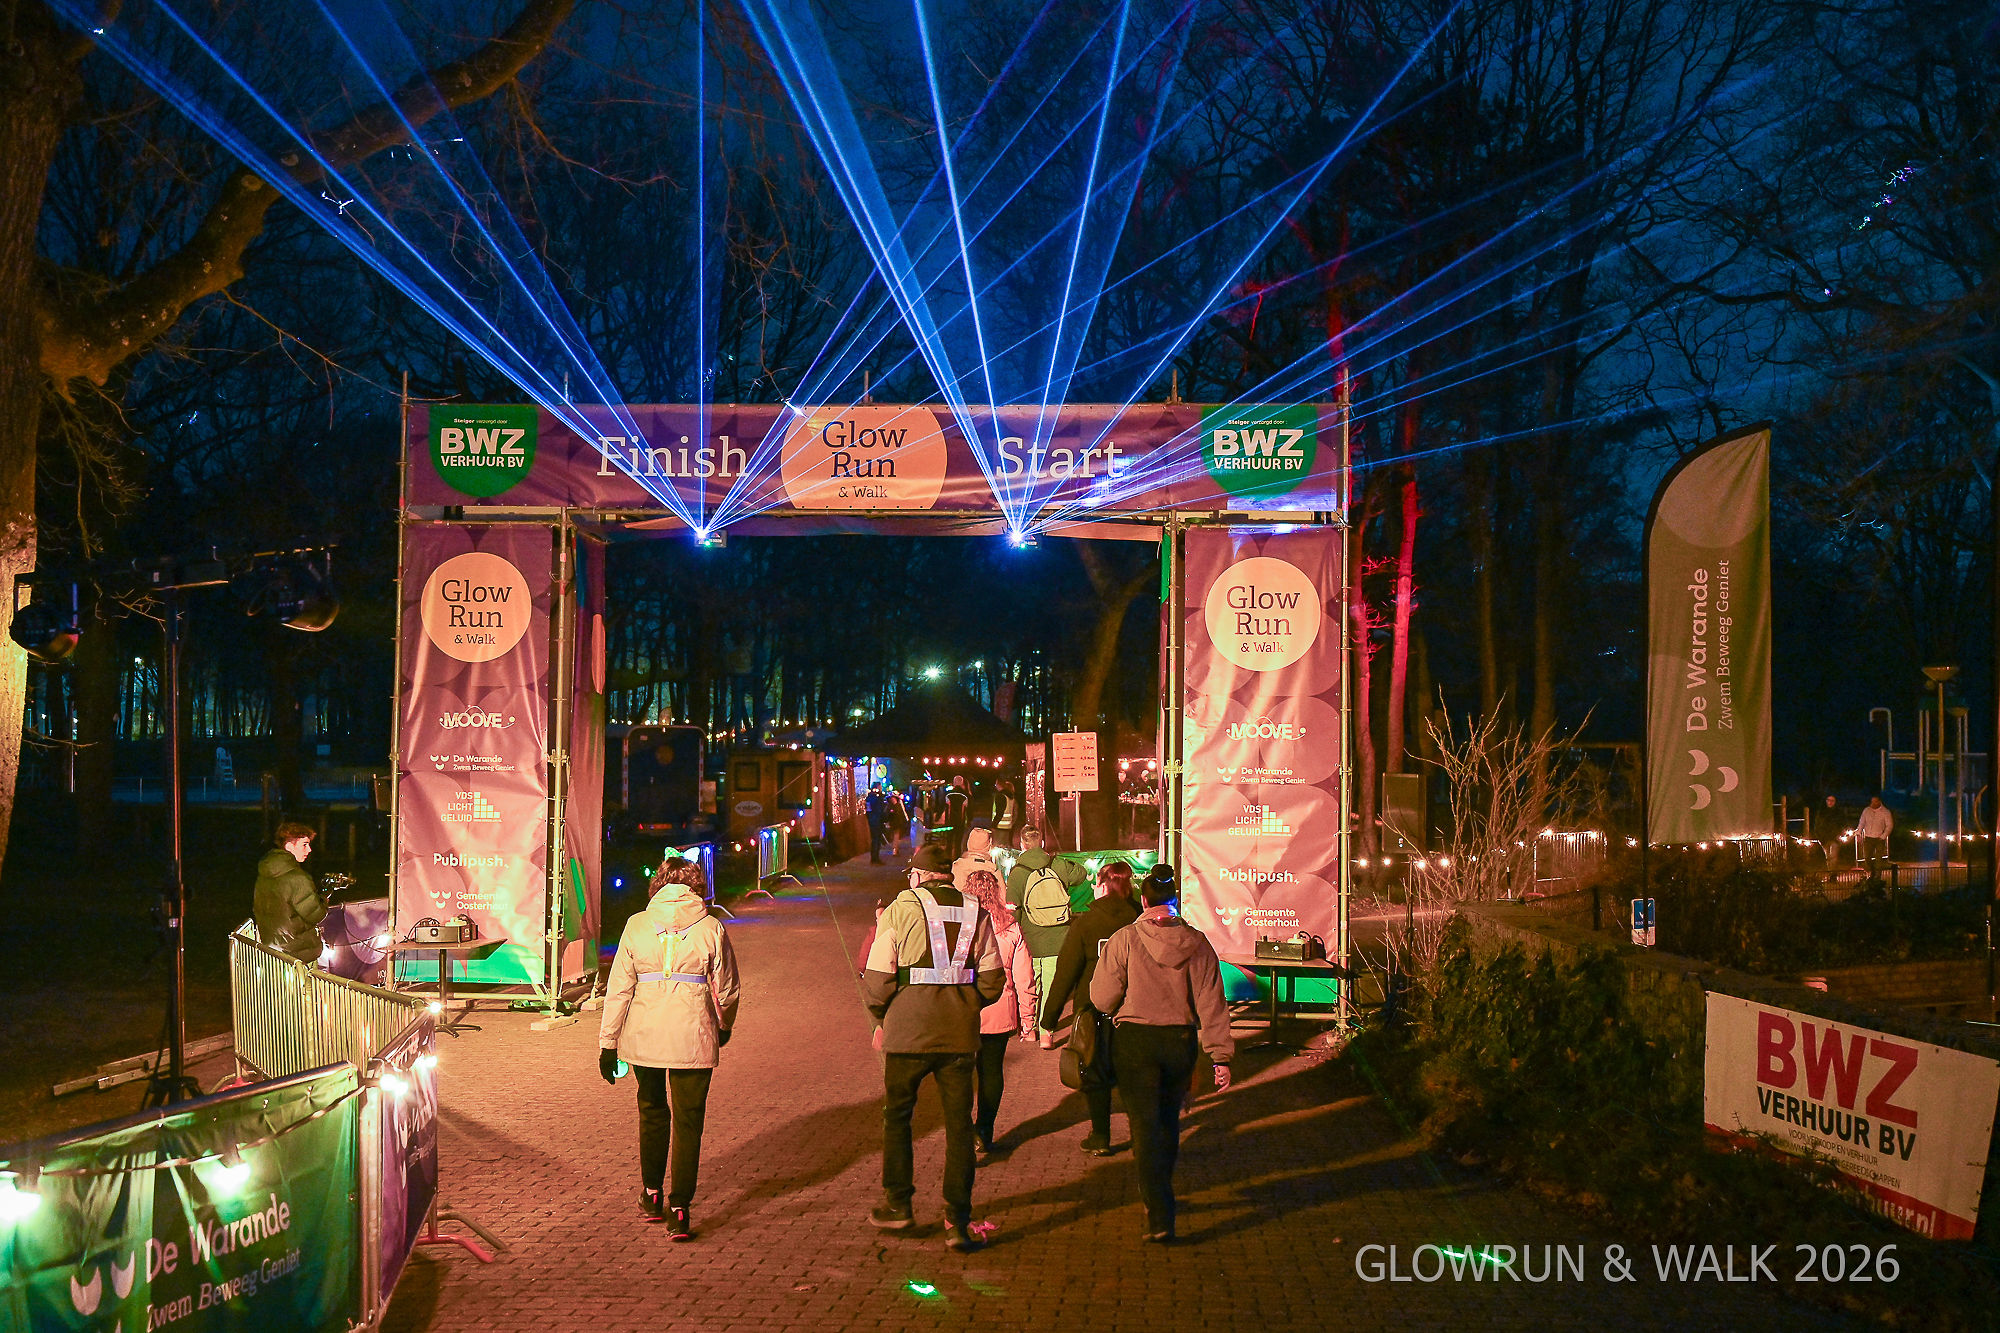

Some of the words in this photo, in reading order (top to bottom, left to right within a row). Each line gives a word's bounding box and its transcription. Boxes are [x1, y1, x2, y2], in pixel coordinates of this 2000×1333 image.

[441, 428, 524, 454] BWZ
[822, 420, 908, 448] Glow
[1214, 429, 1304, 456] BWZ
[441, 456, 504, 467] VERHUUR
[508, 457, 524, 468] BV
[596, 436, 750, 478] Finish
[831, 452, 896, 478] Run
[996, 437, 1124, 479] Start
[1214, 458, 1281, 470] VERHUUR
[1284, 459, 1304, 470] BV
[838, 487, 848, 498] &
[852, 486, 888, 498] Walk
[441, 580, 512, 602] Glow
[1716, 560, 1730, 612] Geniet
[1226, 586, 1300, 609] Glow
[448, 604, 504, 628] Run
[1234, 612, 1292, 636] Run
[454, 634, 463, 644] &
[466, 634, 496, 644] Walk
[1686, 568, 1709, 688] Warande
[1240, 642, 1250, 652] &
[1254, 642, 1284, 653] Walk
[1716, 617, 1733, 676] Beweeg
[1686, 696, 1708, 732] De
[1718, 682, 1733, 730] Zwem
[443, 712, 502, 728] MOOVE
[1231, 723, 1293, 739] MOOVE
[453, 755, 464, 763] De
[466, 755, 503, 763] Warande
[1241, 767, 1253, 775] De
[1255, 767, 1293, 775] Warande
[455, 791, 473, 800] VDS
[441, 814, 473, 822] GELUID
[448, 803, 473, 811] LICHT
[1243, 805, 1262, 813] VDS
[1228, 828, 1261, 836] GELUID
[1235, 817, 1262, 825] LICHT
[1245, 907, 1295, 917] Gemeente
[1245, 918, 1300, 927] Oosterhout
[1757, 1010, 1918, 1129] BWZ
[1757, 1086, 1872, 1150] VERHUUR
[1879, 1123, 1917, 1162] BV
[1837, 1144, 1846, 1156] EN
[1847, 1148, 1878, 1166] VERHUUR
[146, 1238, 178, 1284] De
[189, 1193, 290, 1266] Warande
[146, 1295, 192, 1333] Zwem
[198, 1270, 258, 1310] Beweeg
[261, 1248, 300, 1284] Geniet
